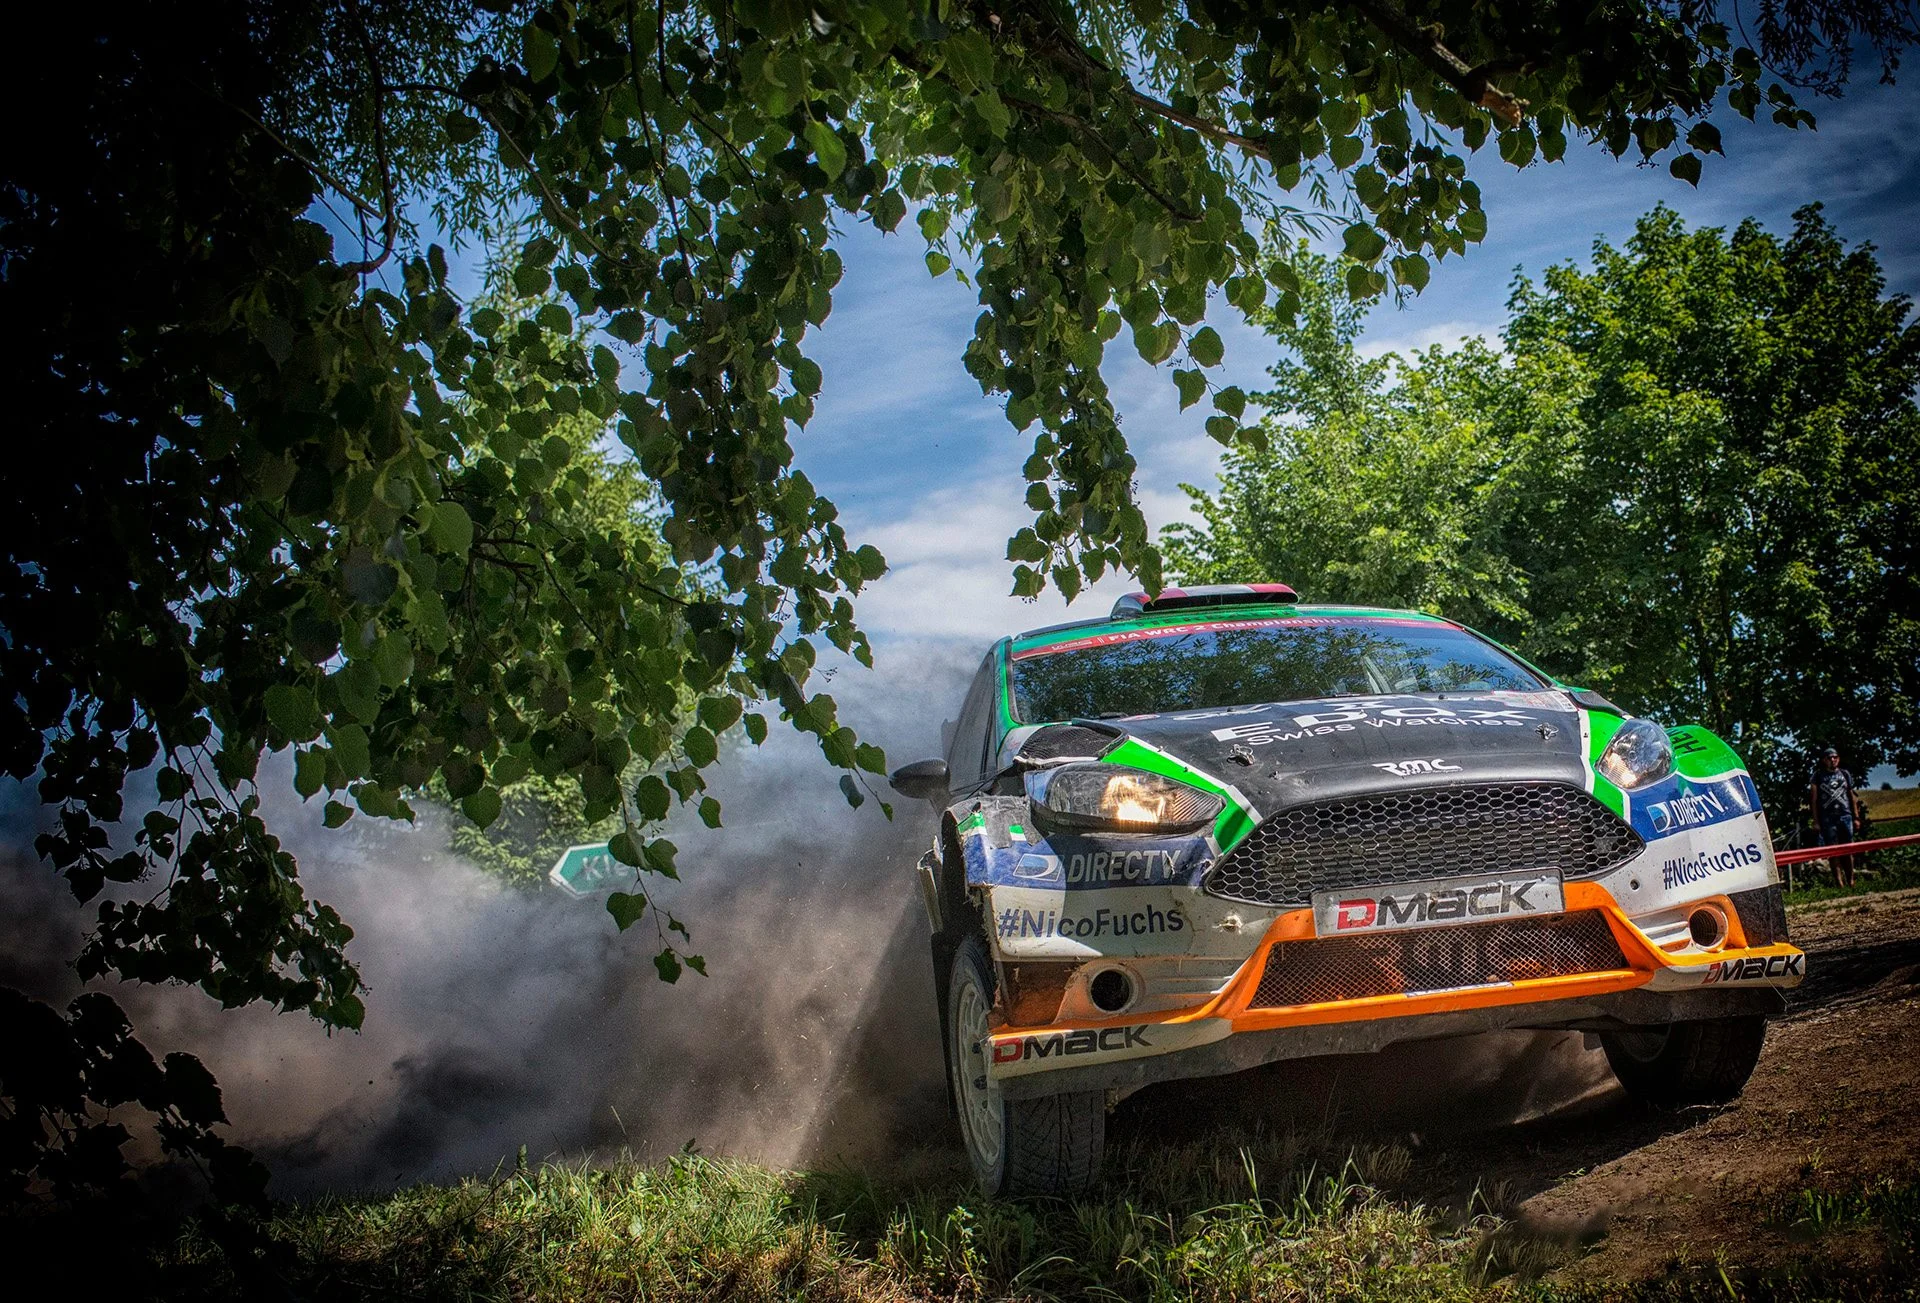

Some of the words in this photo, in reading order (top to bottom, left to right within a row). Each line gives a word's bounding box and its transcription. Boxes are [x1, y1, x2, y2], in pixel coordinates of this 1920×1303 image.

[1108, 632, 1141, 641] FIA
[1146, 627, 1189, 637] WRC
[1193, 624, 1203, 632] 2
[1211, 617, 1341, 630] Championship
[1247, 723, 1356, 746] Swiss
[1363, 716, 1524, 729] Watches
[1066, 850, 1181, 883] DIRECTV
[1662, 843, 1762, 890] #NicoFuchs
[998, 904, 1184, 938] #NicoFuchs
